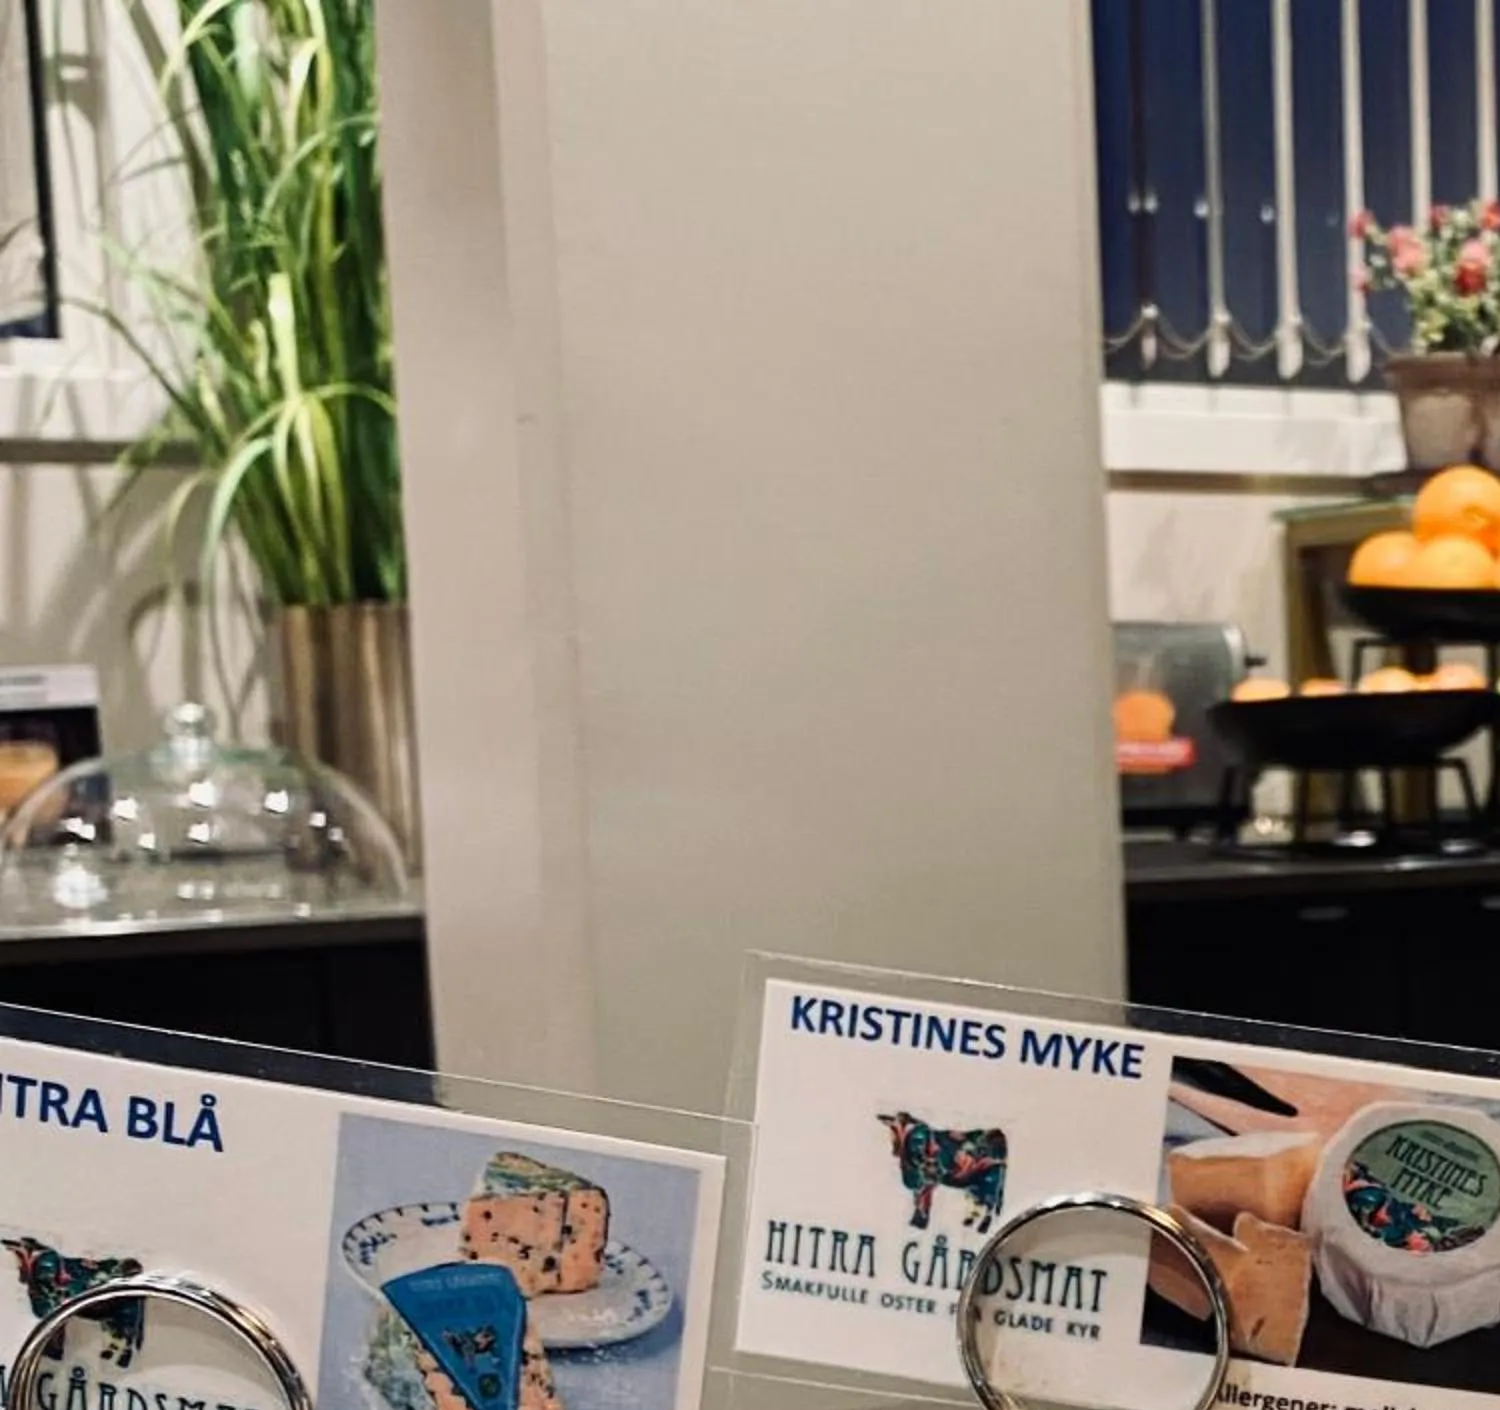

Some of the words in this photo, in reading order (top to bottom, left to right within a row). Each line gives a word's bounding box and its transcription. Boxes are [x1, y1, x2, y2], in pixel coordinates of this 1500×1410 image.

[790, 994, 1007, 1060] KRISTINES
[1019, 1029, 1146, 1080] MYKE
[0, 1072, 109, 1134] TRA
[126, 1093, 224, 1152] BLÅ
[764, 1219, 877, 1279] HITRA
[880, 1292, 937, 1316] OSTER
[993, 1309, 1056, 1334] GLADE
[1066, 1322, 1103, 1341] KYR
